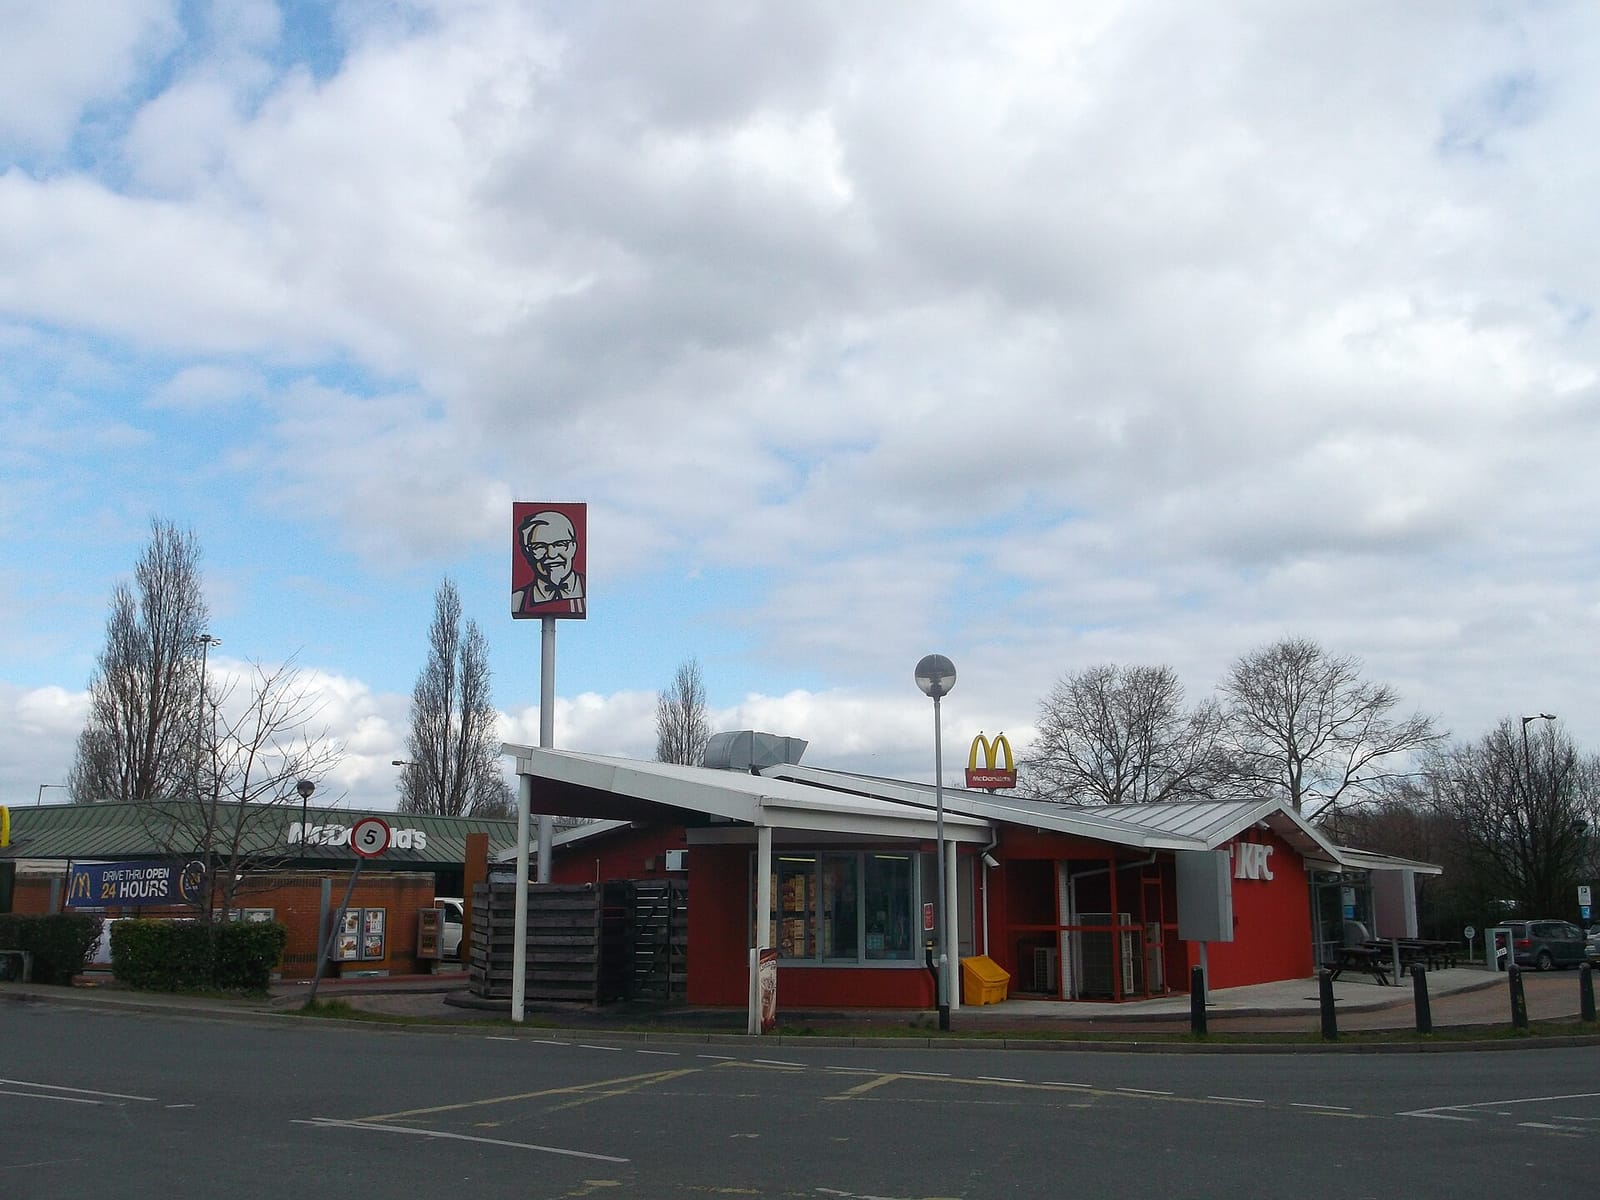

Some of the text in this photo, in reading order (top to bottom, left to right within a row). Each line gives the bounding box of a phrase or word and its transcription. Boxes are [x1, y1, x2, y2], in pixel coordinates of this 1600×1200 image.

[288, 822, 427, 850] McDld's
[364, 829, 377, 845] 5
[1234, 842, 1273, 880] KFC
[103, 868, 170, 882] DRIVE THRU OPEN
[101, 883, 116, 899] 24
[120, 880, 168, 898] HOURS
